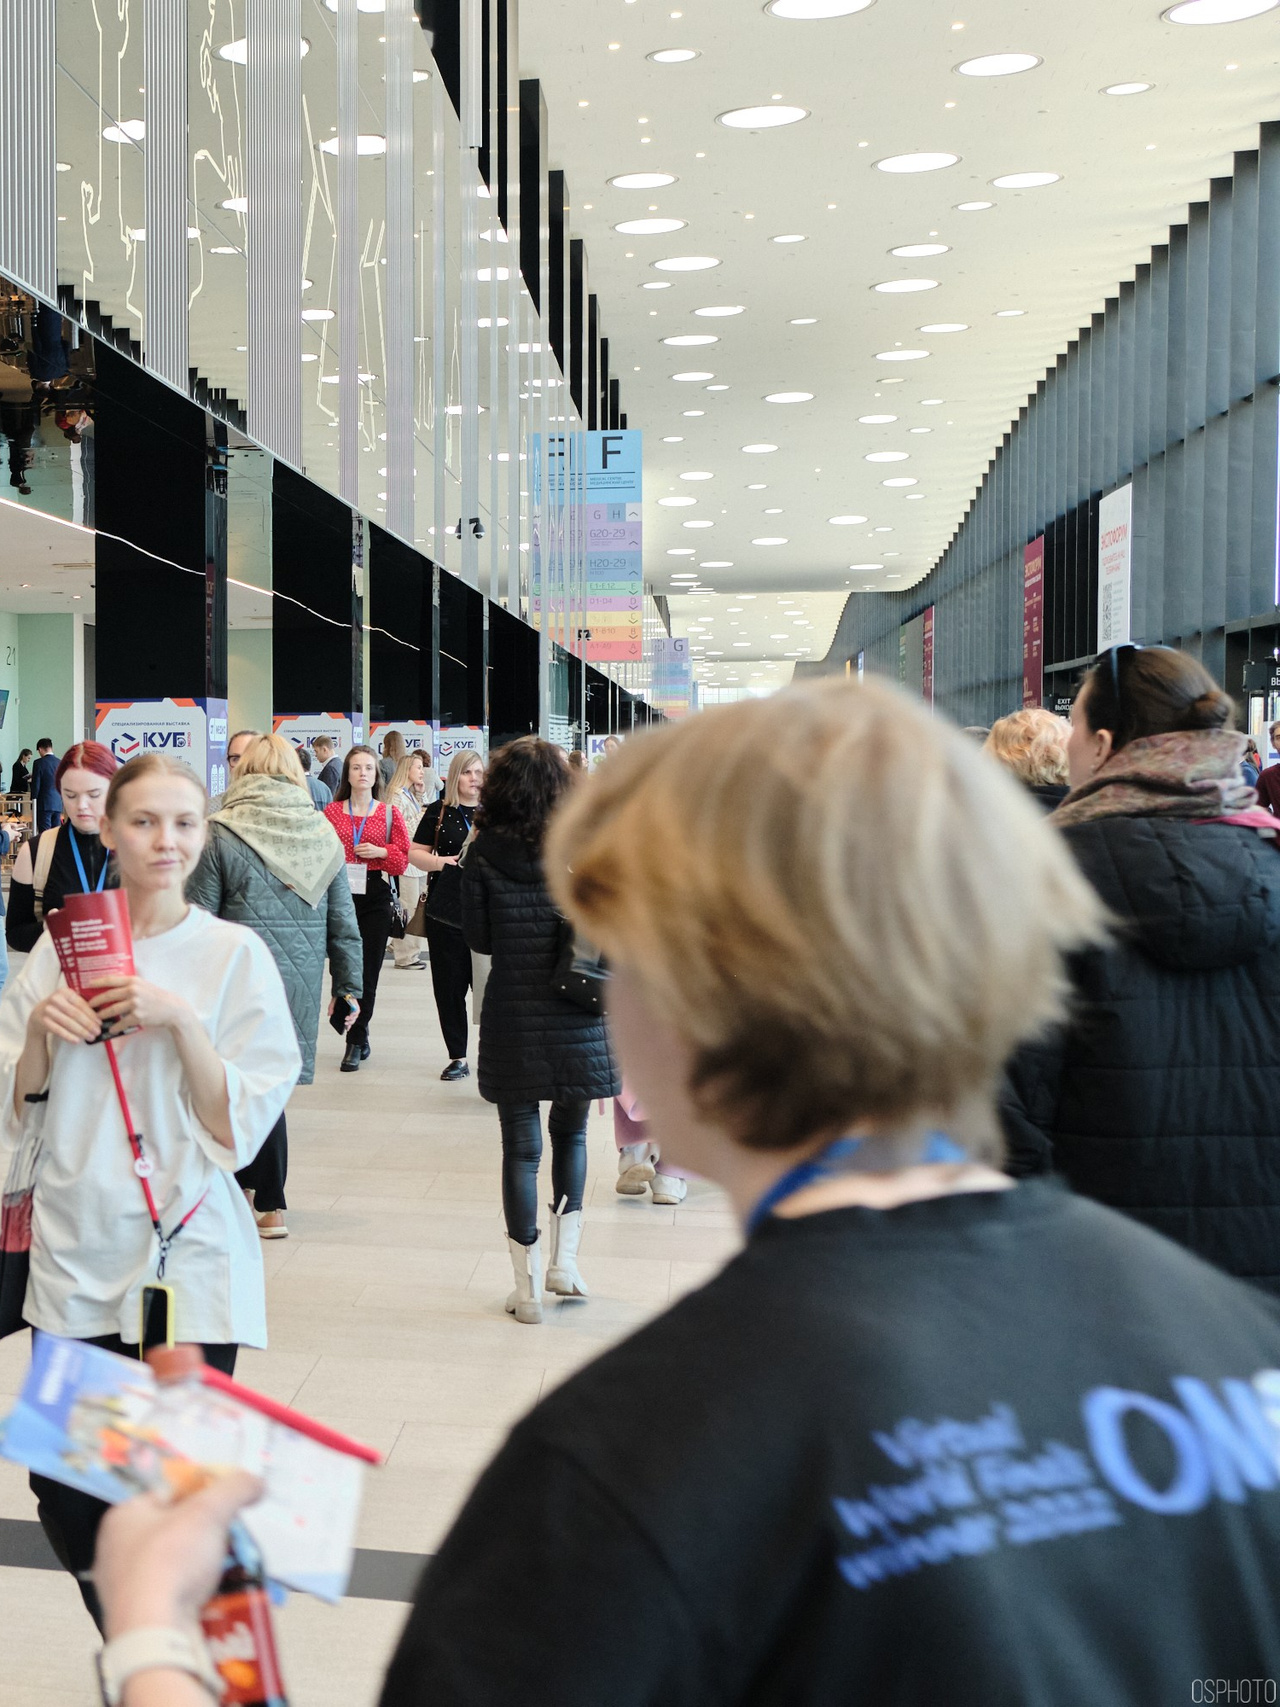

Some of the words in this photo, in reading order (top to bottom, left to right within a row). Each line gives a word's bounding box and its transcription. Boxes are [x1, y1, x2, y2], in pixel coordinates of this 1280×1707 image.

[602, 436, 623, 469] F
[593, 510, 601, 520] G
[612, 510, 621, 519] H
[589, 528, 626, 538] G20-29
[589, 558, 626, 568] H20-29
[630, 582, 637, 590] E
[630, 597, 637, 605] D
[673, 639, 684, 652] G
[6, 646, 16, 666] 21
[143, 731, 187, 748] КУБ
[454, 741, 474, 749] КУБ
